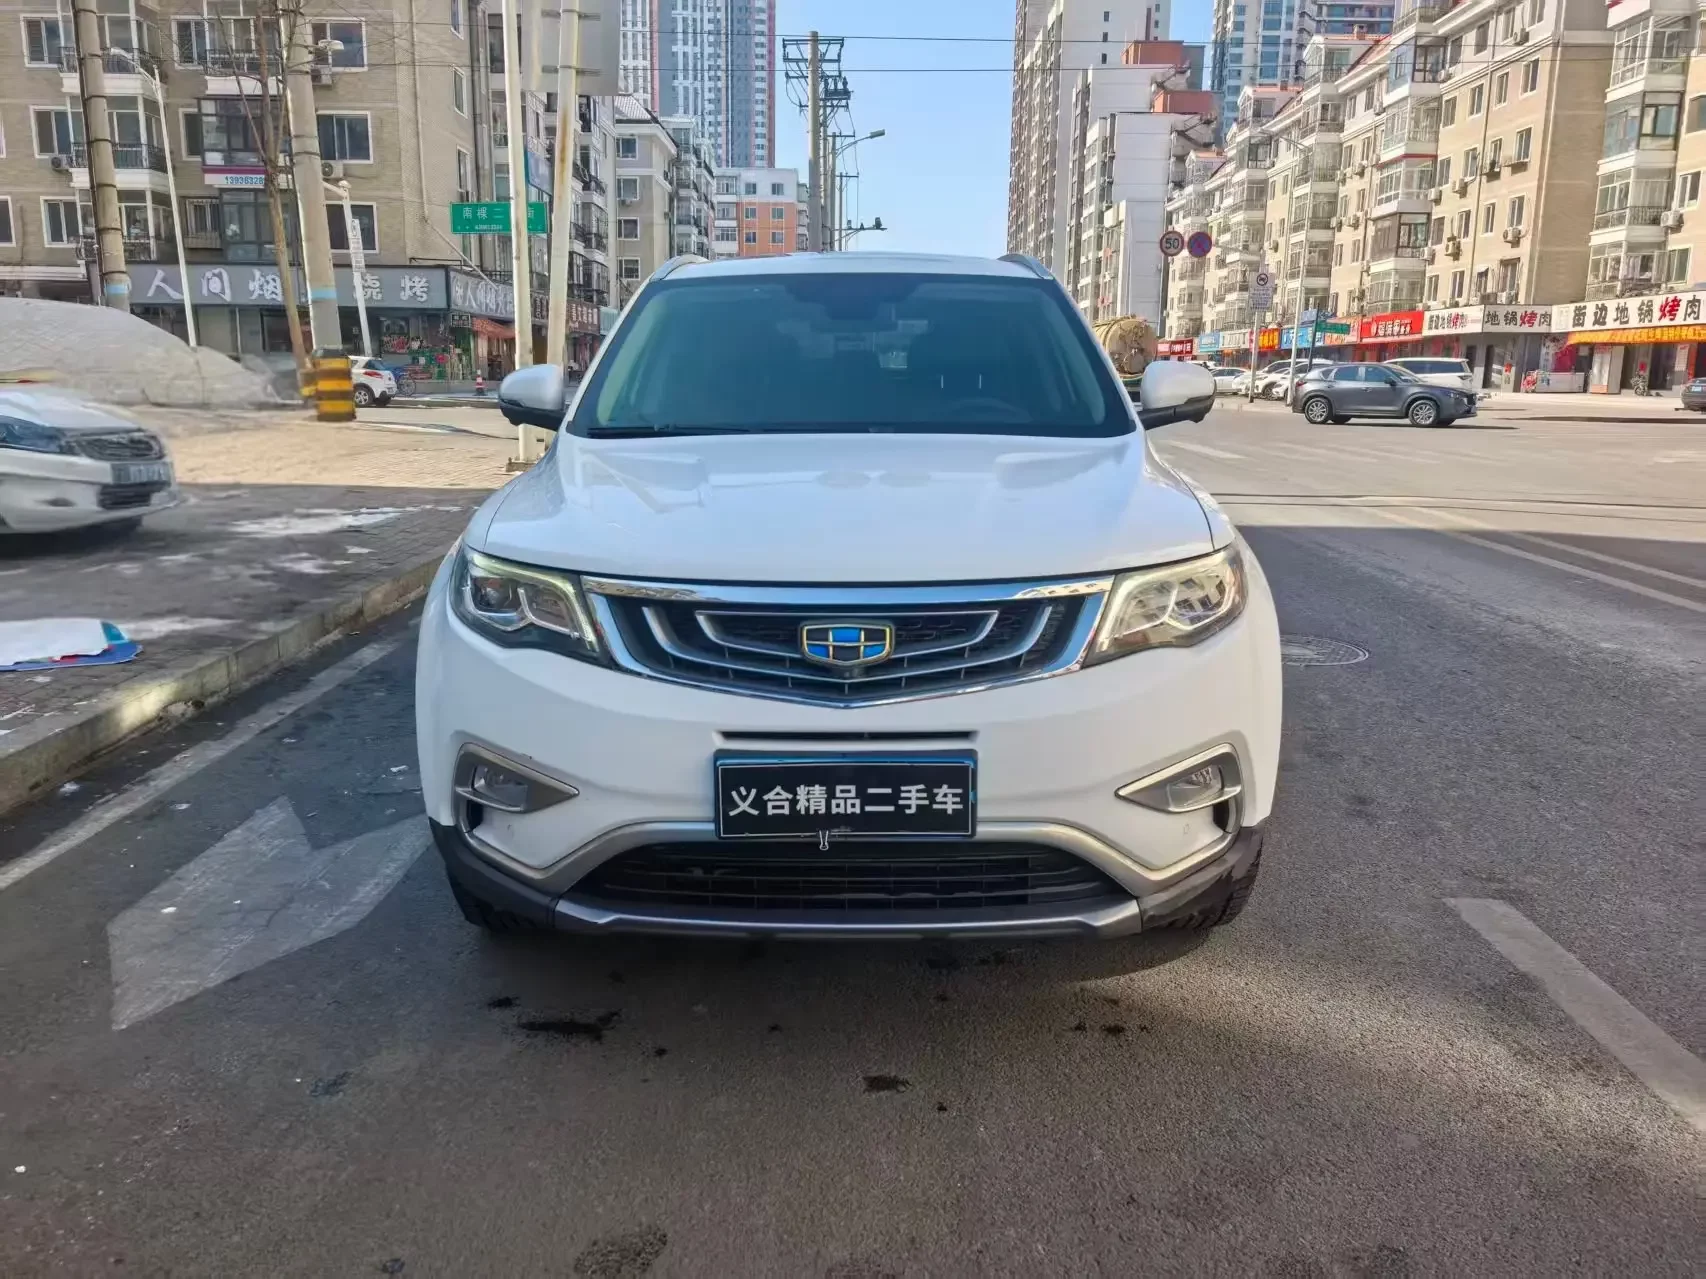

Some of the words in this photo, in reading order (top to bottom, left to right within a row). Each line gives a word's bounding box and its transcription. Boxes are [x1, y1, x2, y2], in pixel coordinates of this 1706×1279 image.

[1165, 238, 1180, 250] 50
[1485, 310, 1552, 328] 地锅烤肉
[1571, 296, 1701, 328] 街边地锅烤肉
[728, 784, 964, 816] 义合精品二手车
